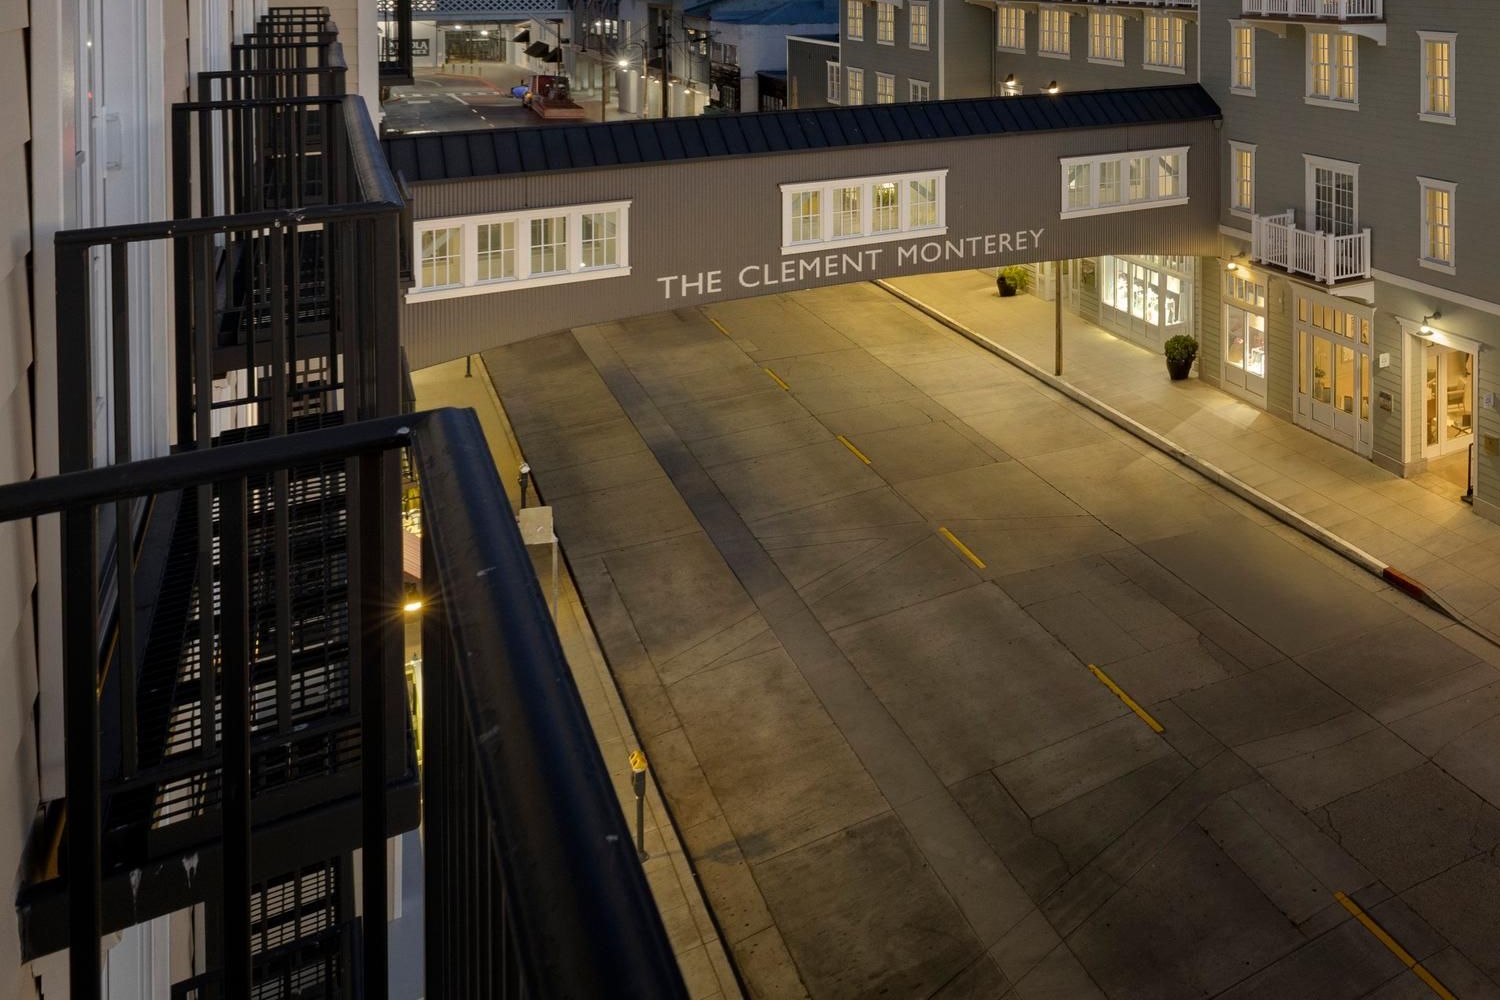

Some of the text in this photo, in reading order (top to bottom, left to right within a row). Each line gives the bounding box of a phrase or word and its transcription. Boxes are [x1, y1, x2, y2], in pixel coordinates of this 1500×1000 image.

[656, 228, 1044, 299] THE CLEMENT MONTEREY
